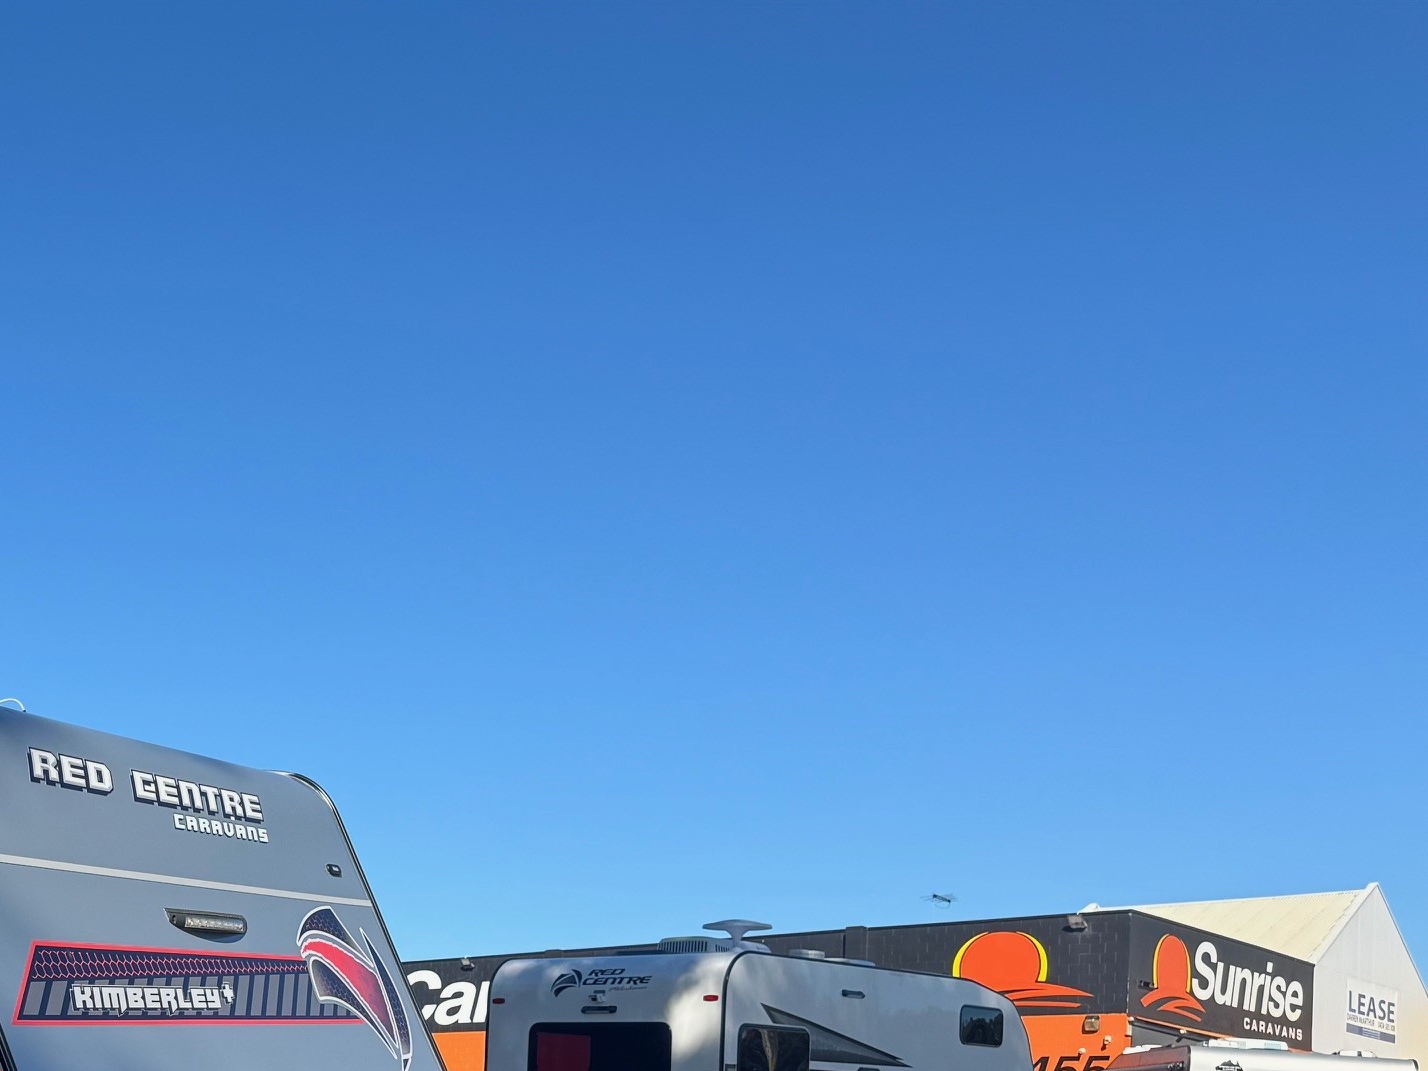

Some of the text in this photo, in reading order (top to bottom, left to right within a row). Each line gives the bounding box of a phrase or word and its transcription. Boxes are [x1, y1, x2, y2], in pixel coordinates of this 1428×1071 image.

[27, 747, 264, 824] RED CENTRE
[173, 814, 269, 843] CARAVANS
[582, 975, 652, 986] CENTRE
[588, 968, 626, 977] RED
[1192, 941, 1304, 1022] Sunrise
[1348, 990, 1396, 1024] LEASE
[1243, 1017, 1303, 1041] CARAVANS
